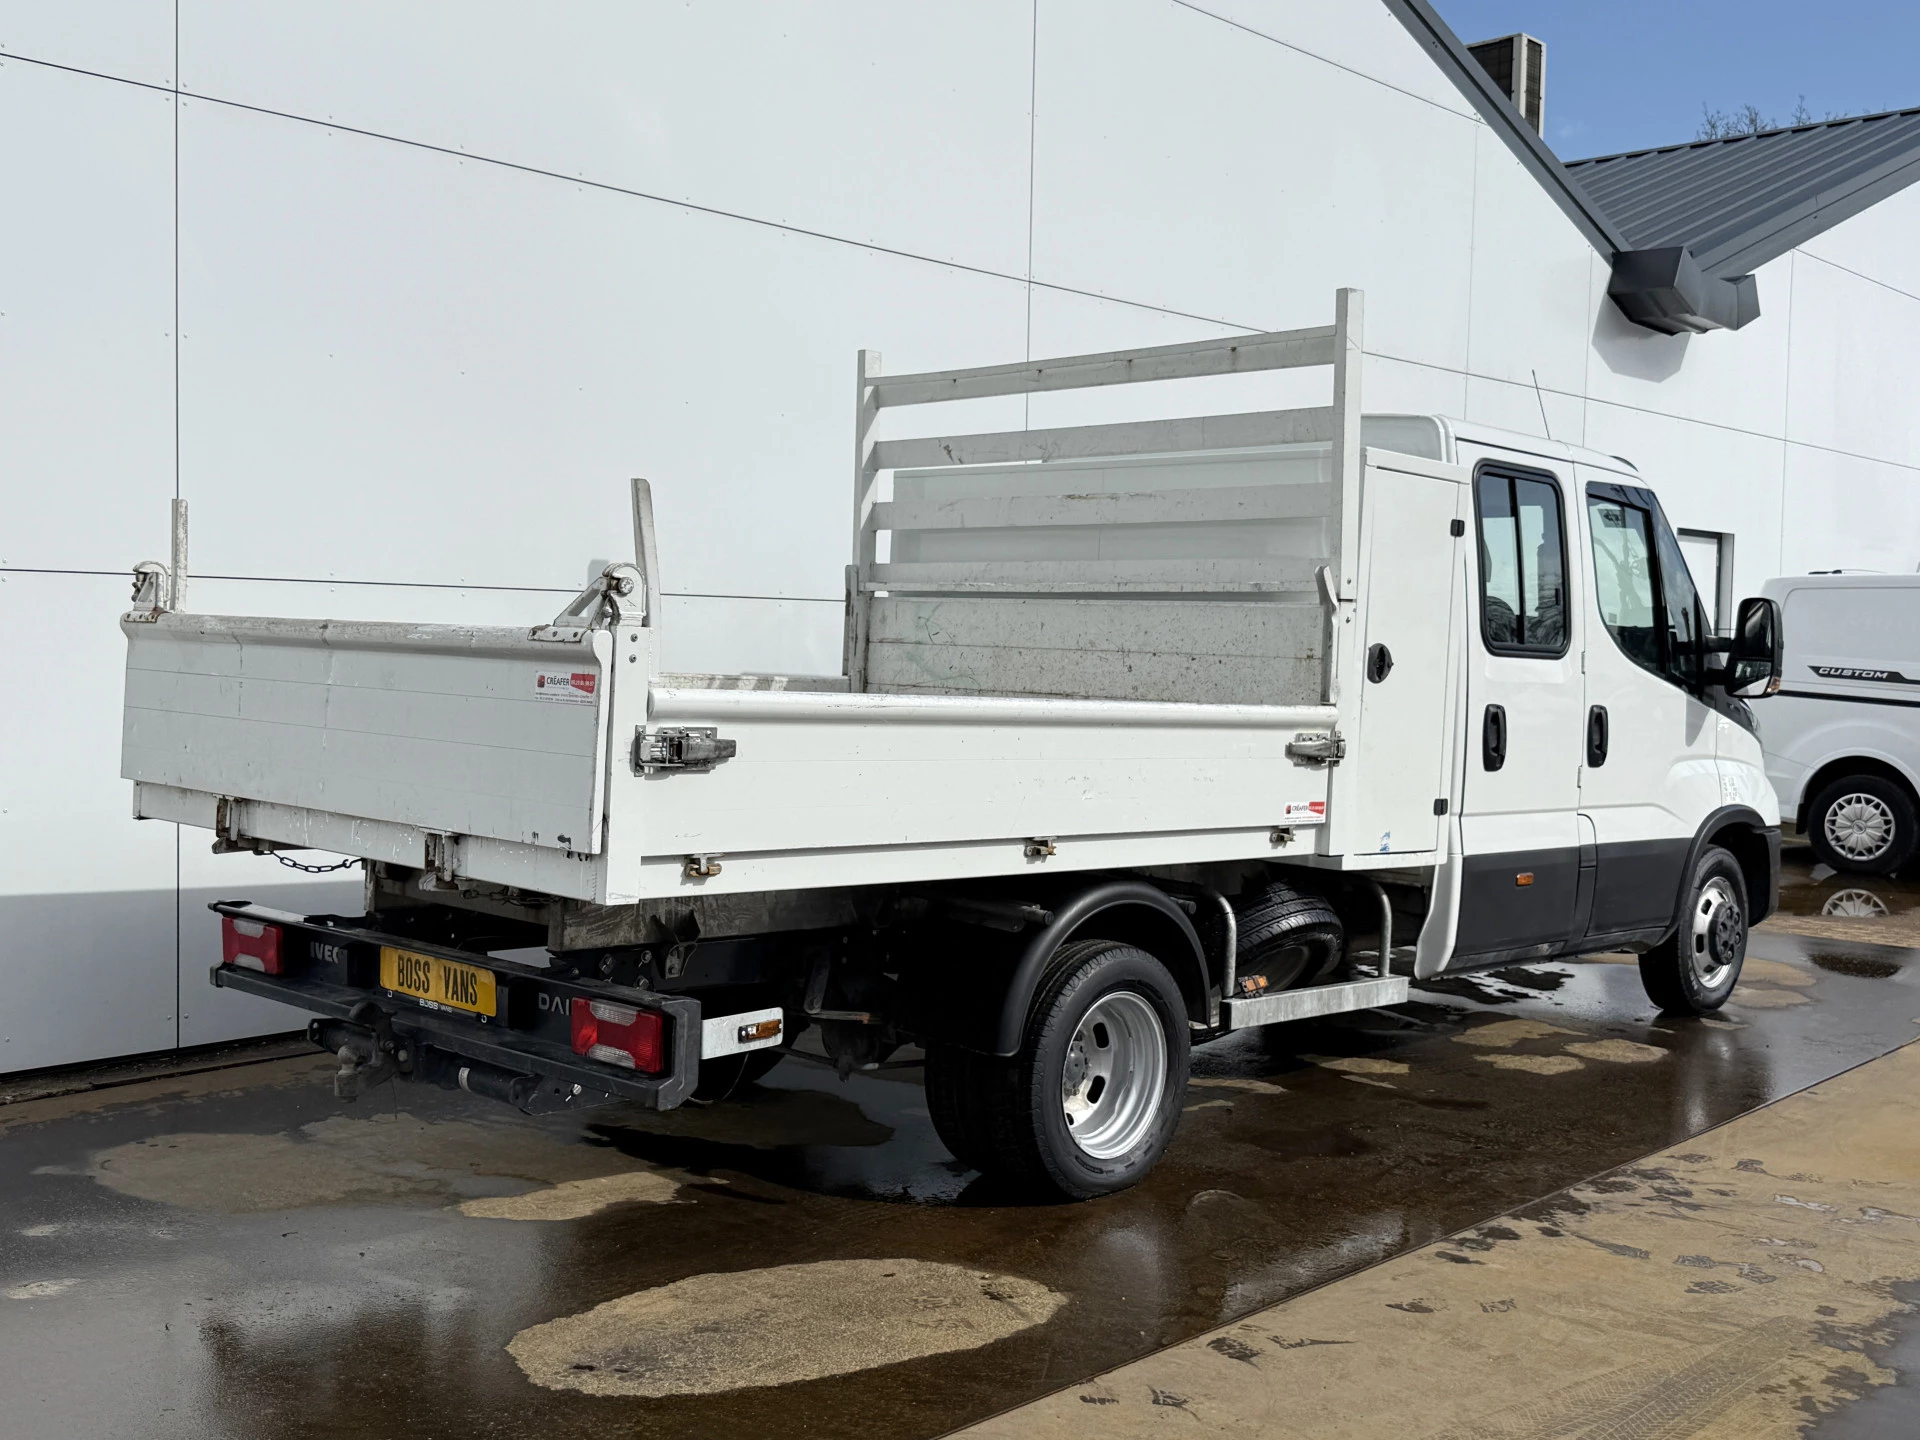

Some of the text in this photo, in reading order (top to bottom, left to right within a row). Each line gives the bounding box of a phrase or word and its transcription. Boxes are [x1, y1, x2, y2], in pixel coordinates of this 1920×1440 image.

[1818, 667, 1889, 679] CUSTOM
[310, 941, 340, 964] IVEC
[397, 954, 478, 1006] BOSS VANS
[419, 998, 439, 1010] BOSS
[538, 992, 570, 1016] DAI
